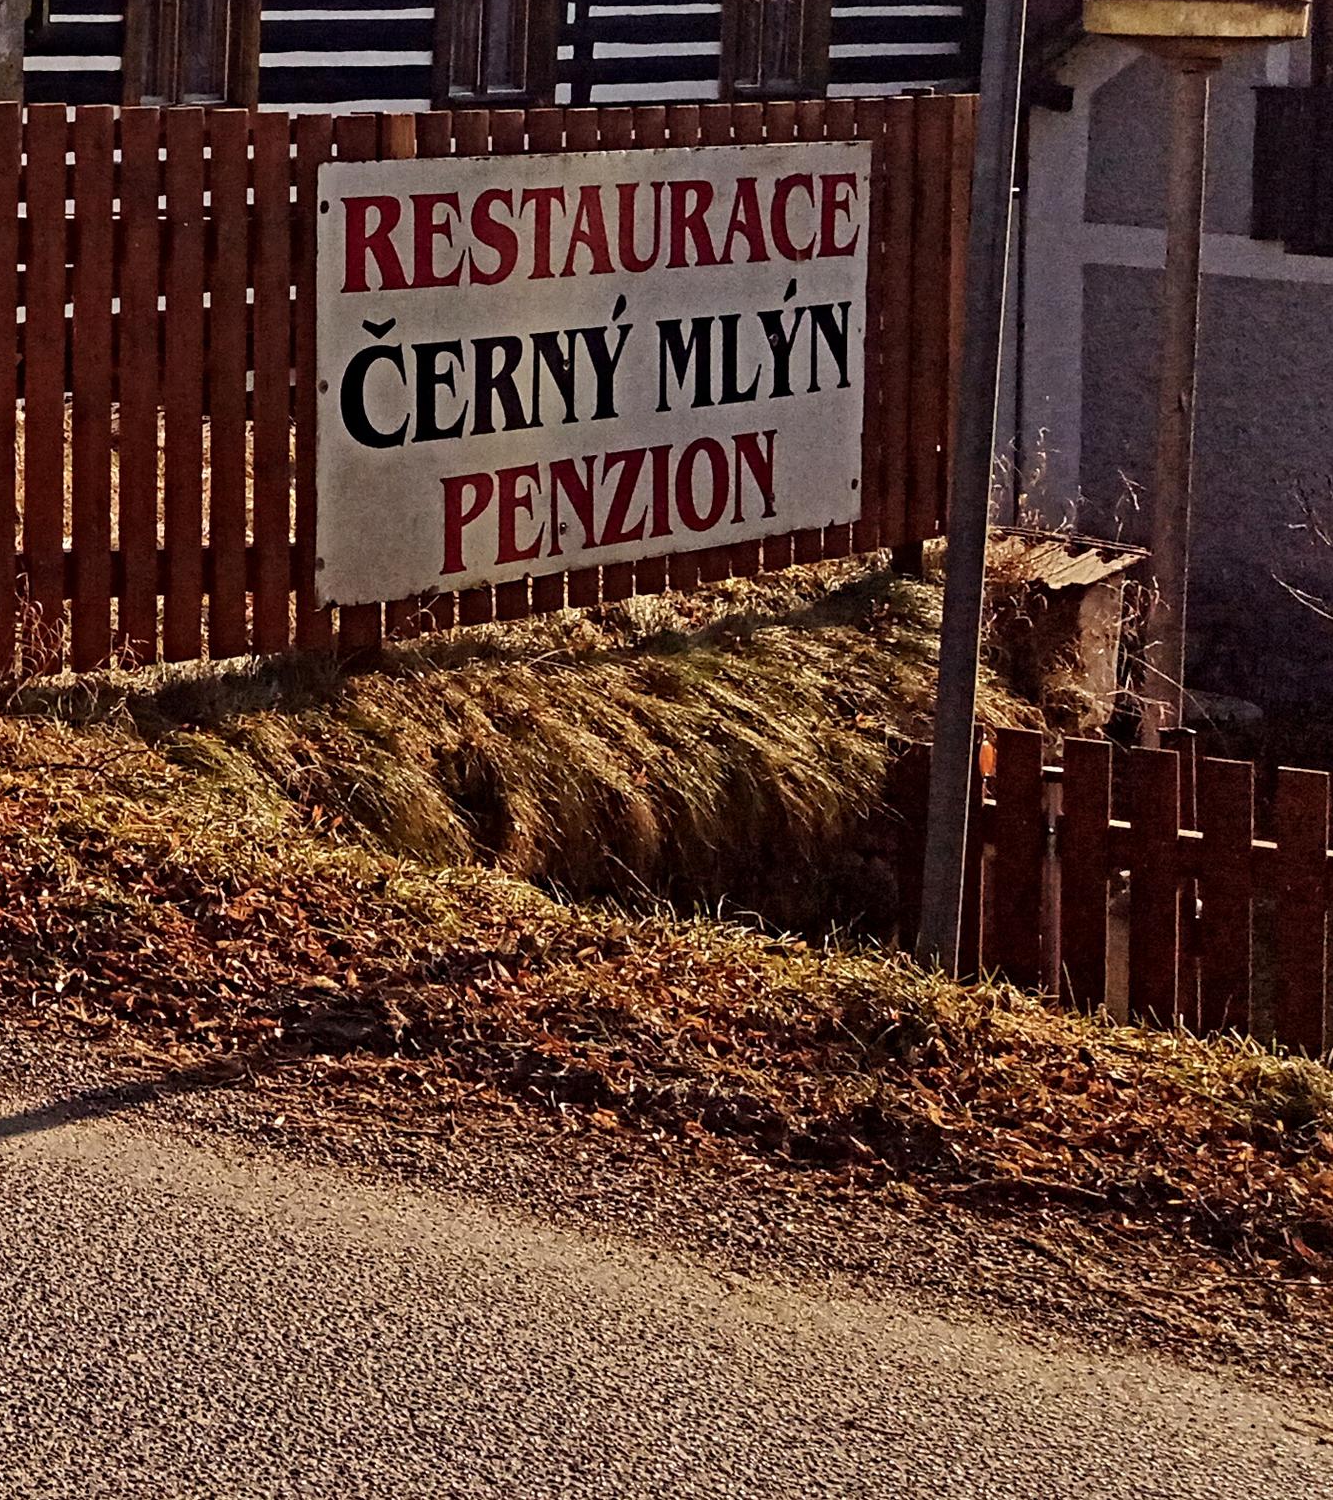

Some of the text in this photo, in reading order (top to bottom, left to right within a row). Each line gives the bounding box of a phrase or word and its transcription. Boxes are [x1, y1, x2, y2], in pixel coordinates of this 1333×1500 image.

[340, 172, 860, 293] RESTAURACE
[340, 278, 852, 449] ČERNÝ MLÝN
[439, 429, 778, 576] PENZION
